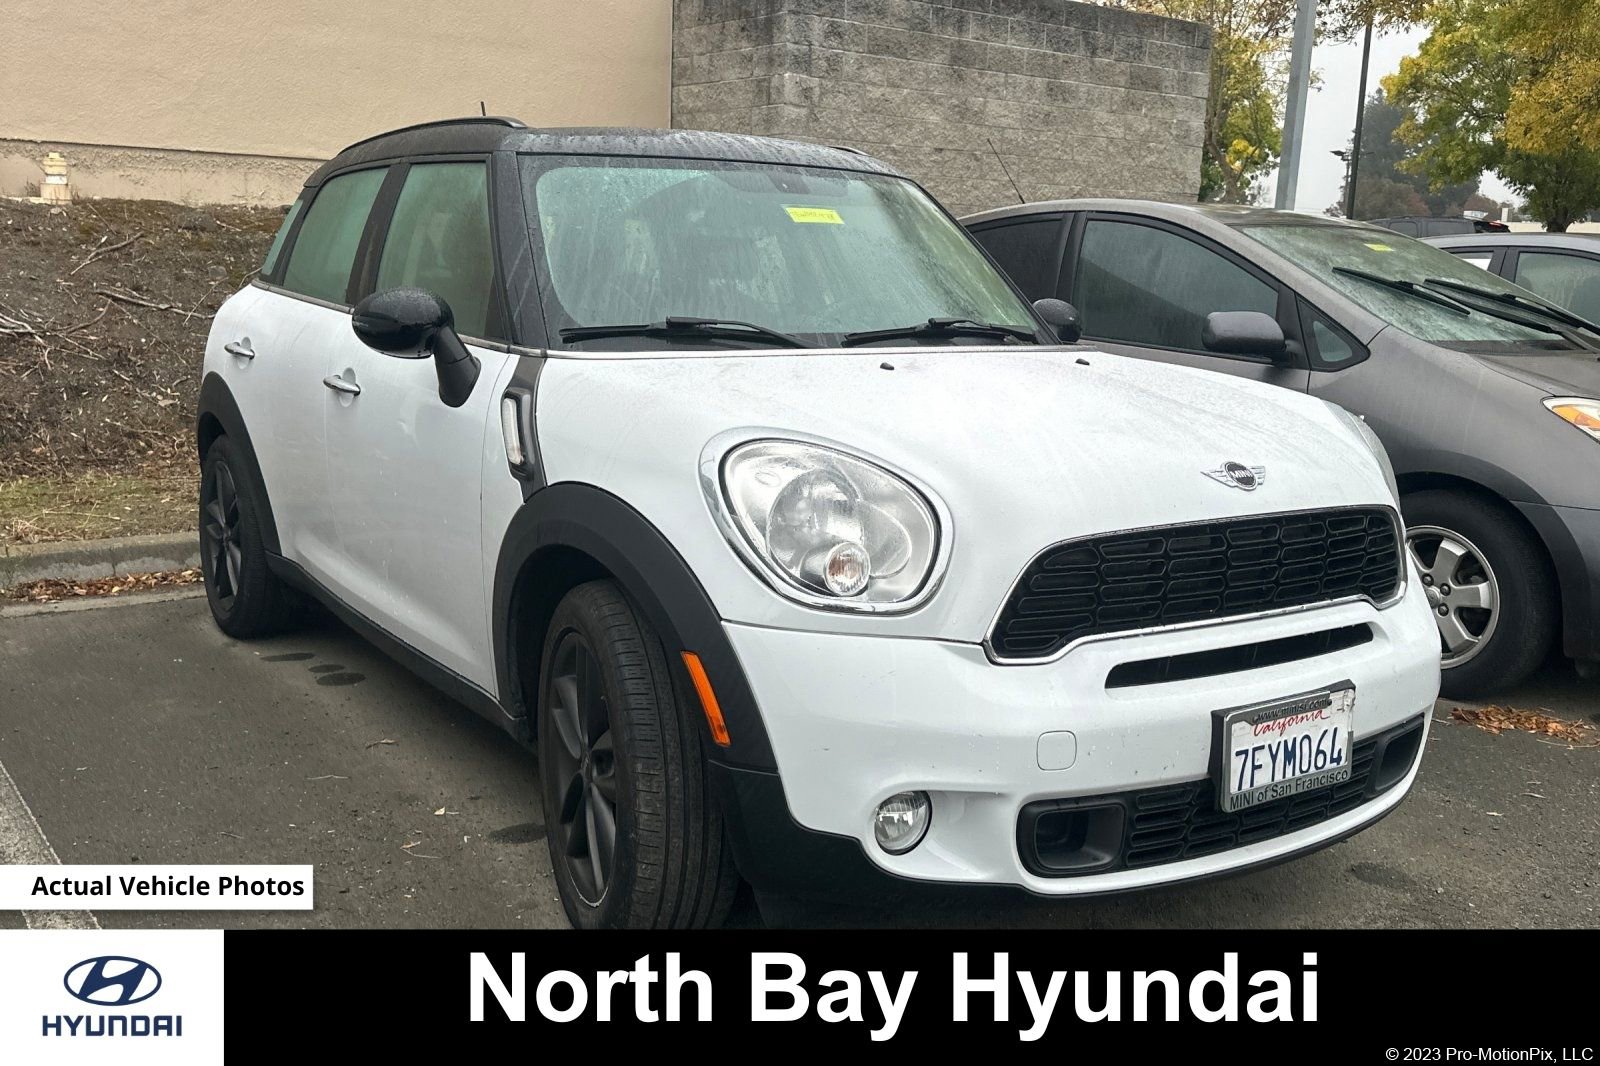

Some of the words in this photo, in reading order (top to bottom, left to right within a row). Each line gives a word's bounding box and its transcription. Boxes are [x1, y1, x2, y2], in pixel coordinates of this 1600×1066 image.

[1254, 709, 1331, 737] California
[1235, 726, 1343, 792] 7FYM064
[1230, 794, 1255, 811] MINI
[1257, 788, 1270, 804] of
[1271, 784, 1292, 799] San
[1295, 769, 1348, 793] Francisco
